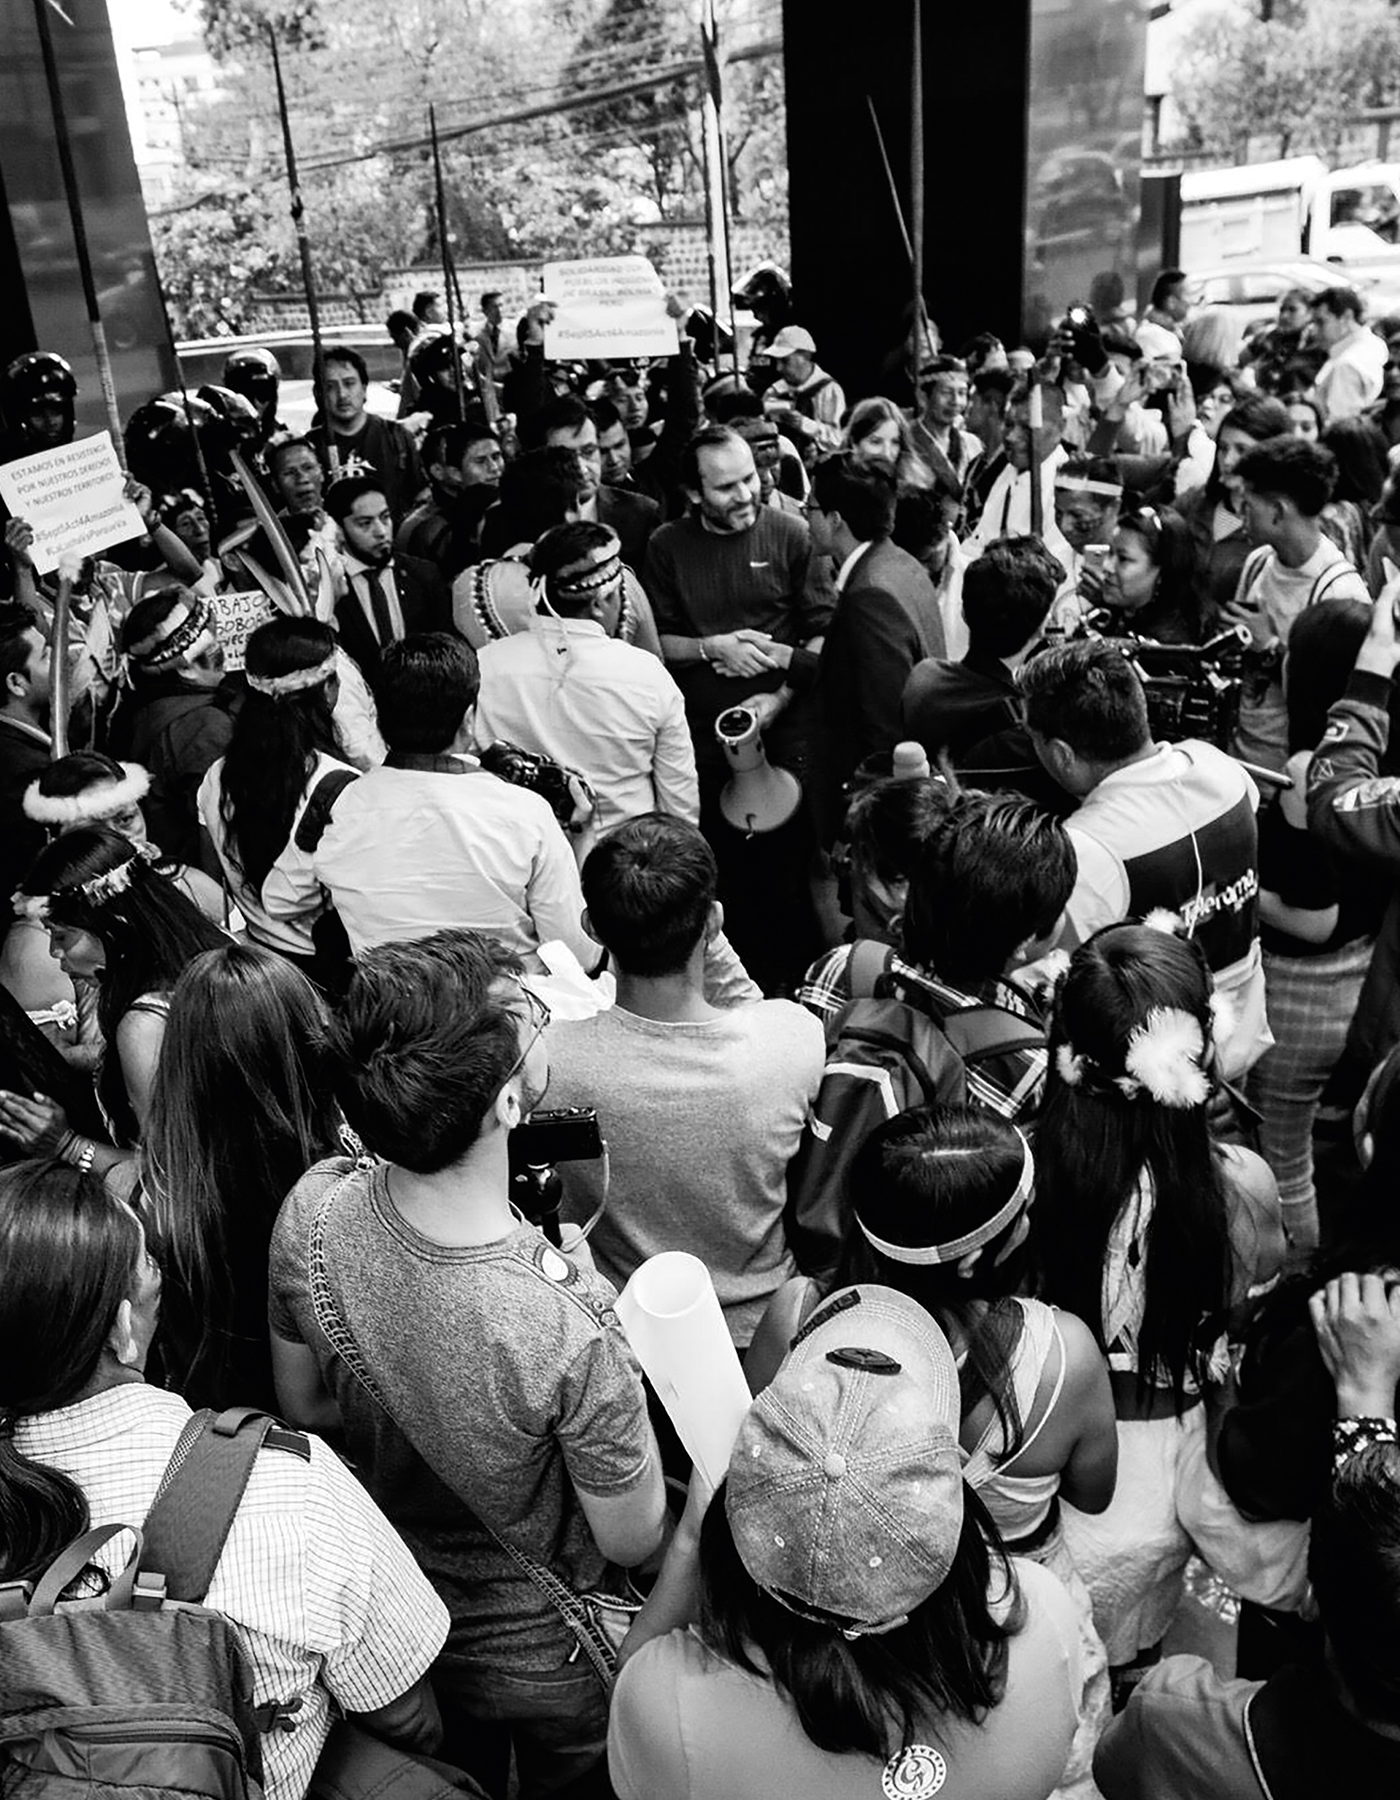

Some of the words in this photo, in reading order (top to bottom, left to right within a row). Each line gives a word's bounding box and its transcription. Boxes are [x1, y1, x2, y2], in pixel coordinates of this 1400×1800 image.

[11, 460, 54, 480] ESTAMOS
[54, 456, 66, 468] EN
[16, 483, 36, 495] POR
[37, 468, 79, 487] NUESTROS
[32, 487, 73, 505] NUESTROS
[208, 594, 266, 615] ABAJO
